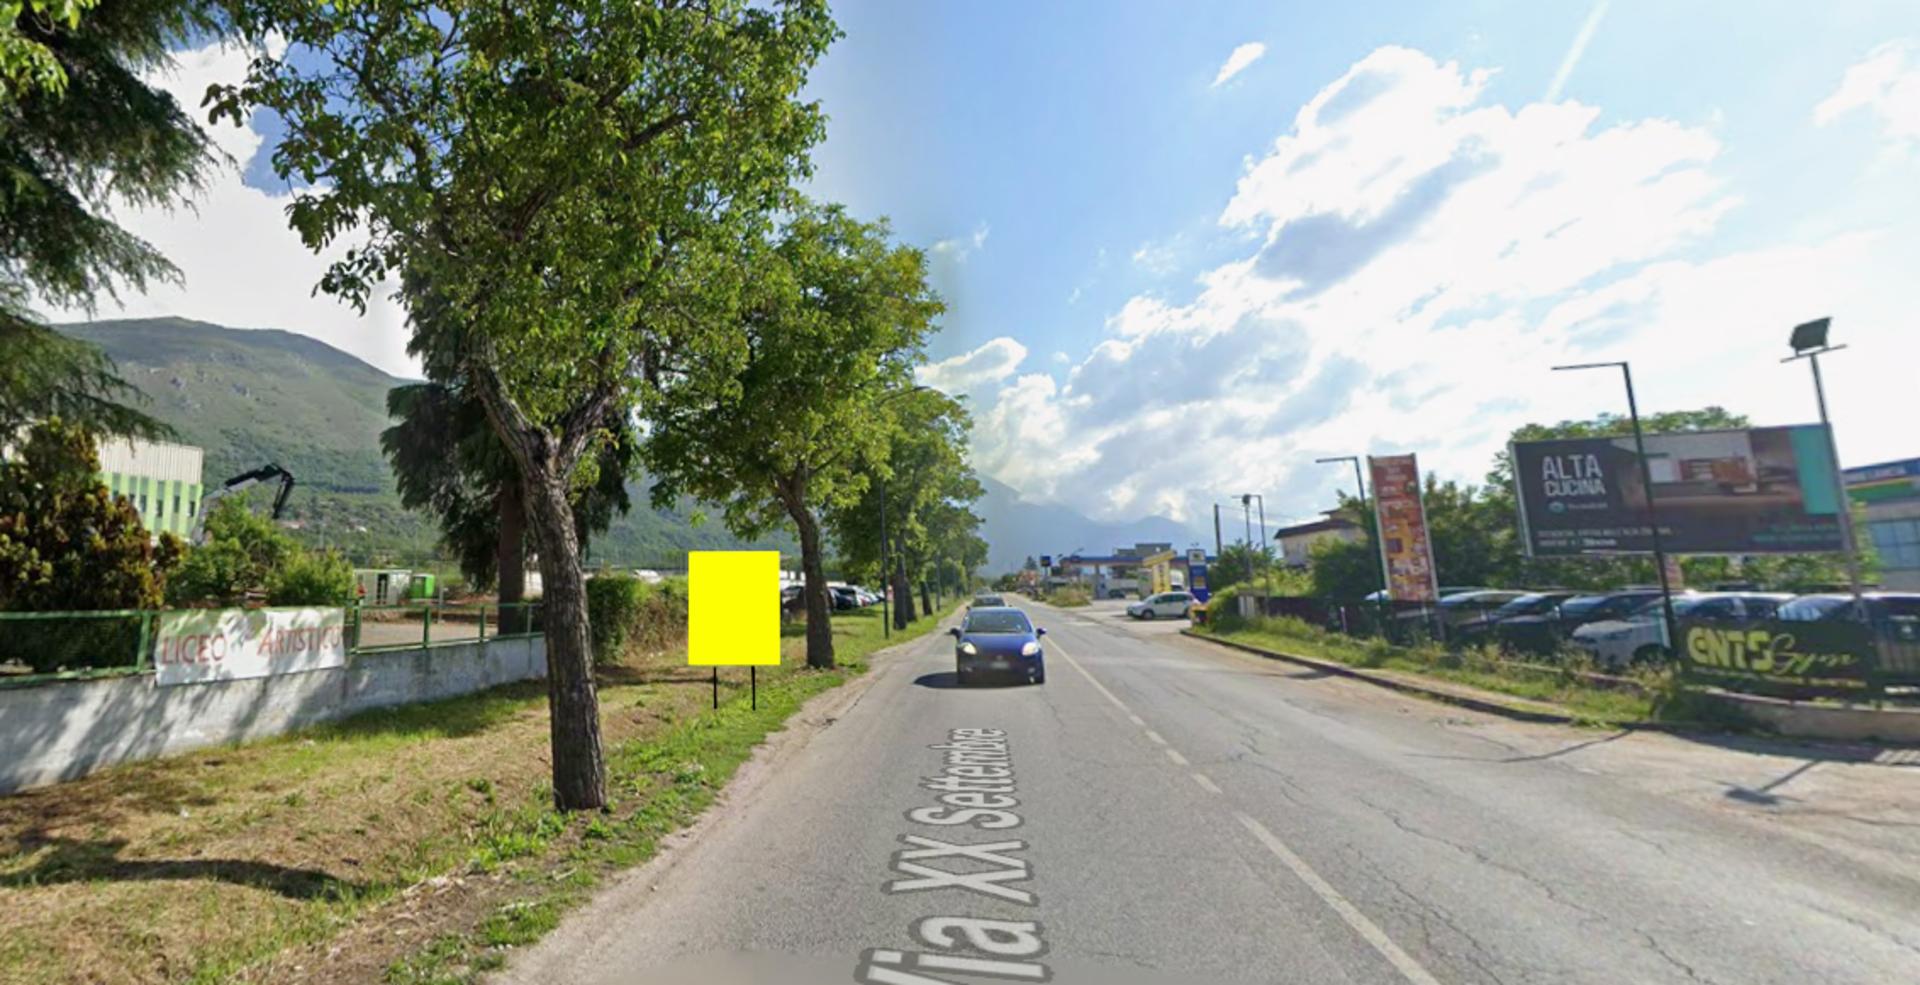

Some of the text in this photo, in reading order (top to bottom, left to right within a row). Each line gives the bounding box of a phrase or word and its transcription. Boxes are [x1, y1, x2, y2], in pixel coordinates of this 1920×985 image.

[1542, 454, 1603, 480] ALTA
[1544, 479, 1607, 497] CUCINA
[161, 632, 228, 667] LICEO
